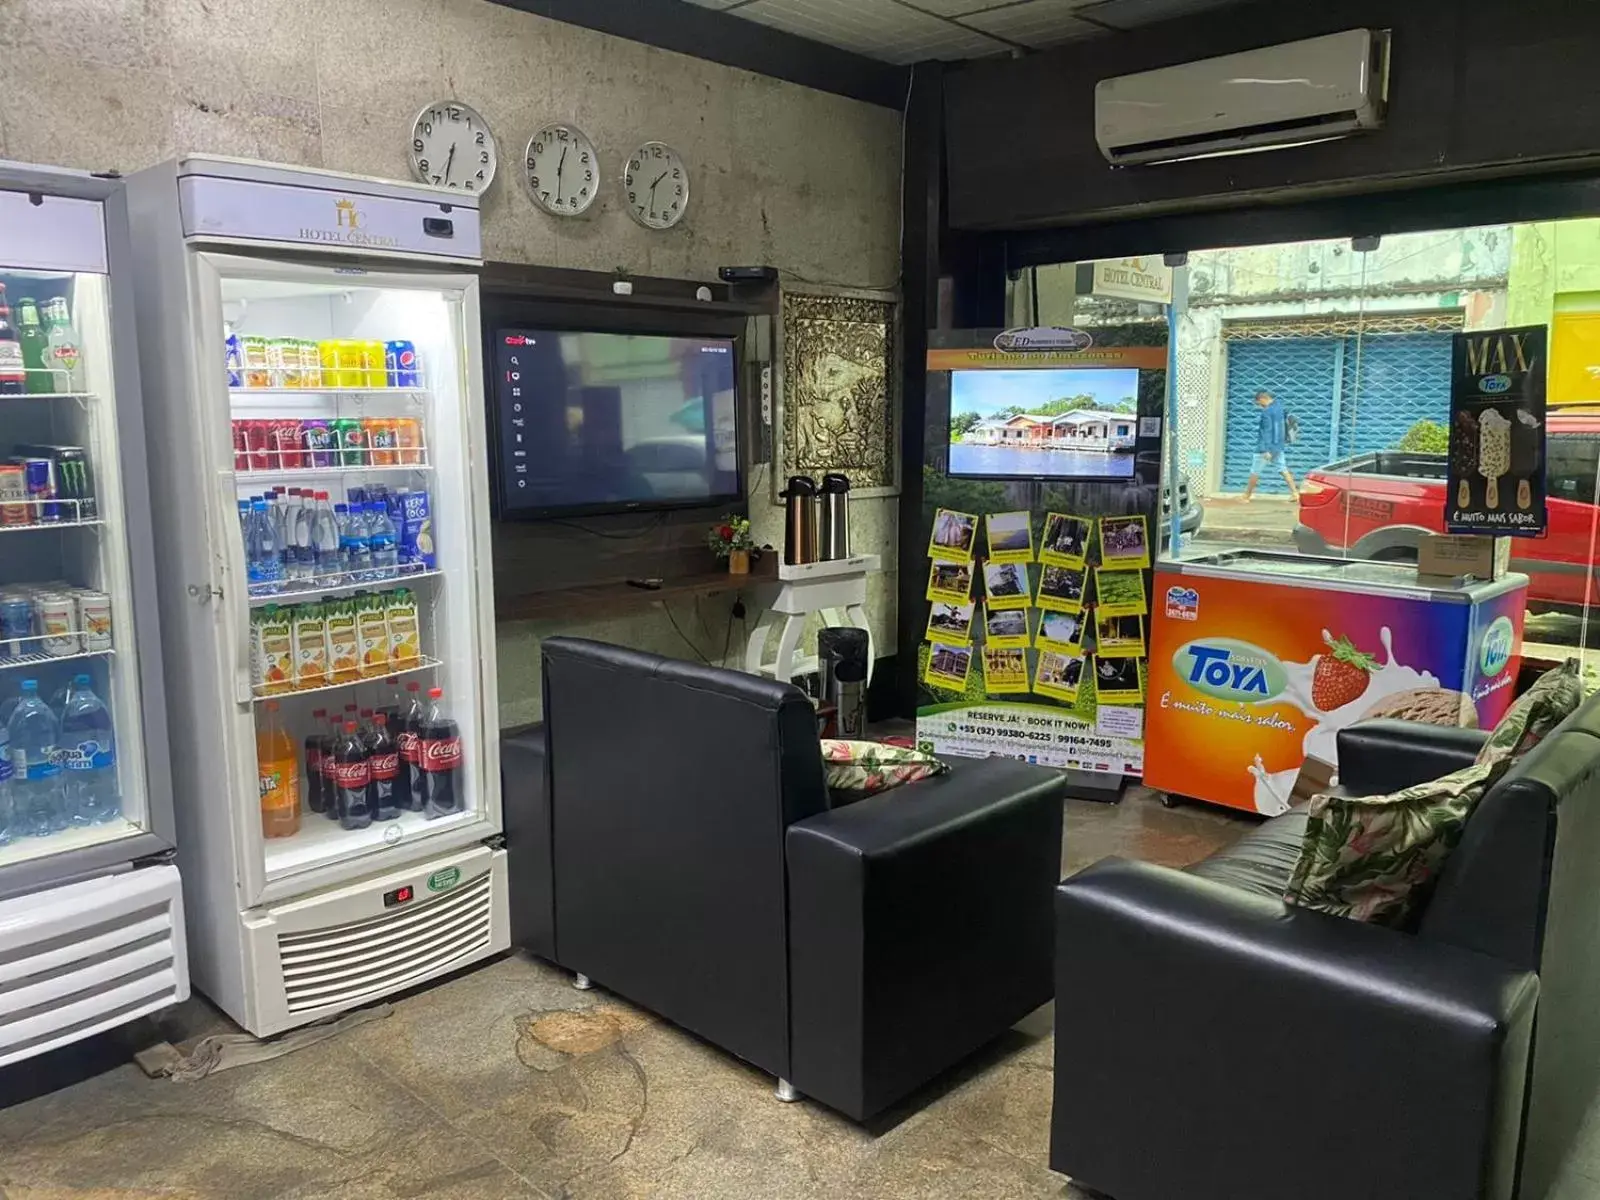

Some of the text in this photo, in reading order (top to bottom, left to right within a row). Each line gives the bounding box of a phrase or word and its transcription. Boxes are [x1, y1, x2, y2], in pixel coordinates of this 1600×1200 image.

[430, 110, 442, 124] 11
[445, 107, 460, 121] 12
[418, 122, 432, 138] 10
[466, 117, 471, 131] 1
[475, 132, 484, 145] 2
[543, 131, 553, 143] 11
[555, 129, 568, 142] 12
[413, 139, 424, 153] 9
[532, 142, 543, 154] 10
[572, 138, 578, 149] 1
[480, 151, 489, 164] 3
[581, 152, 588, 164] 2
[639, 149, 649, 160] 11
[651, 147, 662, 159] 12
[420, 159, 429, 172] 8
[527, 157, 536, 170] 9
[630, 160, 641, 172] 10
[665, 155, 670, 166] 1
[475, 170, 484, 180] 4
[584, 170, 592, 181] 3
[673, 168, 680, 179] 2
[432, 175, 441, 185] 7
[465, 181, 473, 191] 5
[531, 176, 539, 188] 8
[626, 174, 633, 186] 9
[580, 187, 587, 196] 4
[675, 184, 682, 196] 3
[542, 191, 549, 202] 7
[570, 197, 577, 208] 5
[629, 192, 636, 204] 8
[638, 206, 645, 217] 7
[671, 204, 677, 214] 4
[662, 210, 669, 222] 5
[299, 228, 402, 247] HOTEL CENTRAL
[1103, 267, 1164, 290] HOTEL CENTRAL
[1465, 332, 1532, 376] MAX
[1453, 510, 1536, 524] É MUITO MAIS SABOR
[1188, 645, 1268, 694] TOYA
[1160, 690, 1171, 708] É
[1173, 701, 1213, 715] muito
[1219, 702, 1252, 724] mais
[967, 711, 1005, 722] RESERVE
[1007, 714, 1020, 723] JÁ!
[1028, 717, 1053, 727] BOOK
[1055, 719, 1063, 727] IT
[1065, 721, 1090, 731] NOW!
[960, 725, 975, 733] +55
[977, 726, 995, 737] (92)
[997, 728, 1051, 742] 99380-6225
[1058, 735, 1112, 749] 99164-7495
